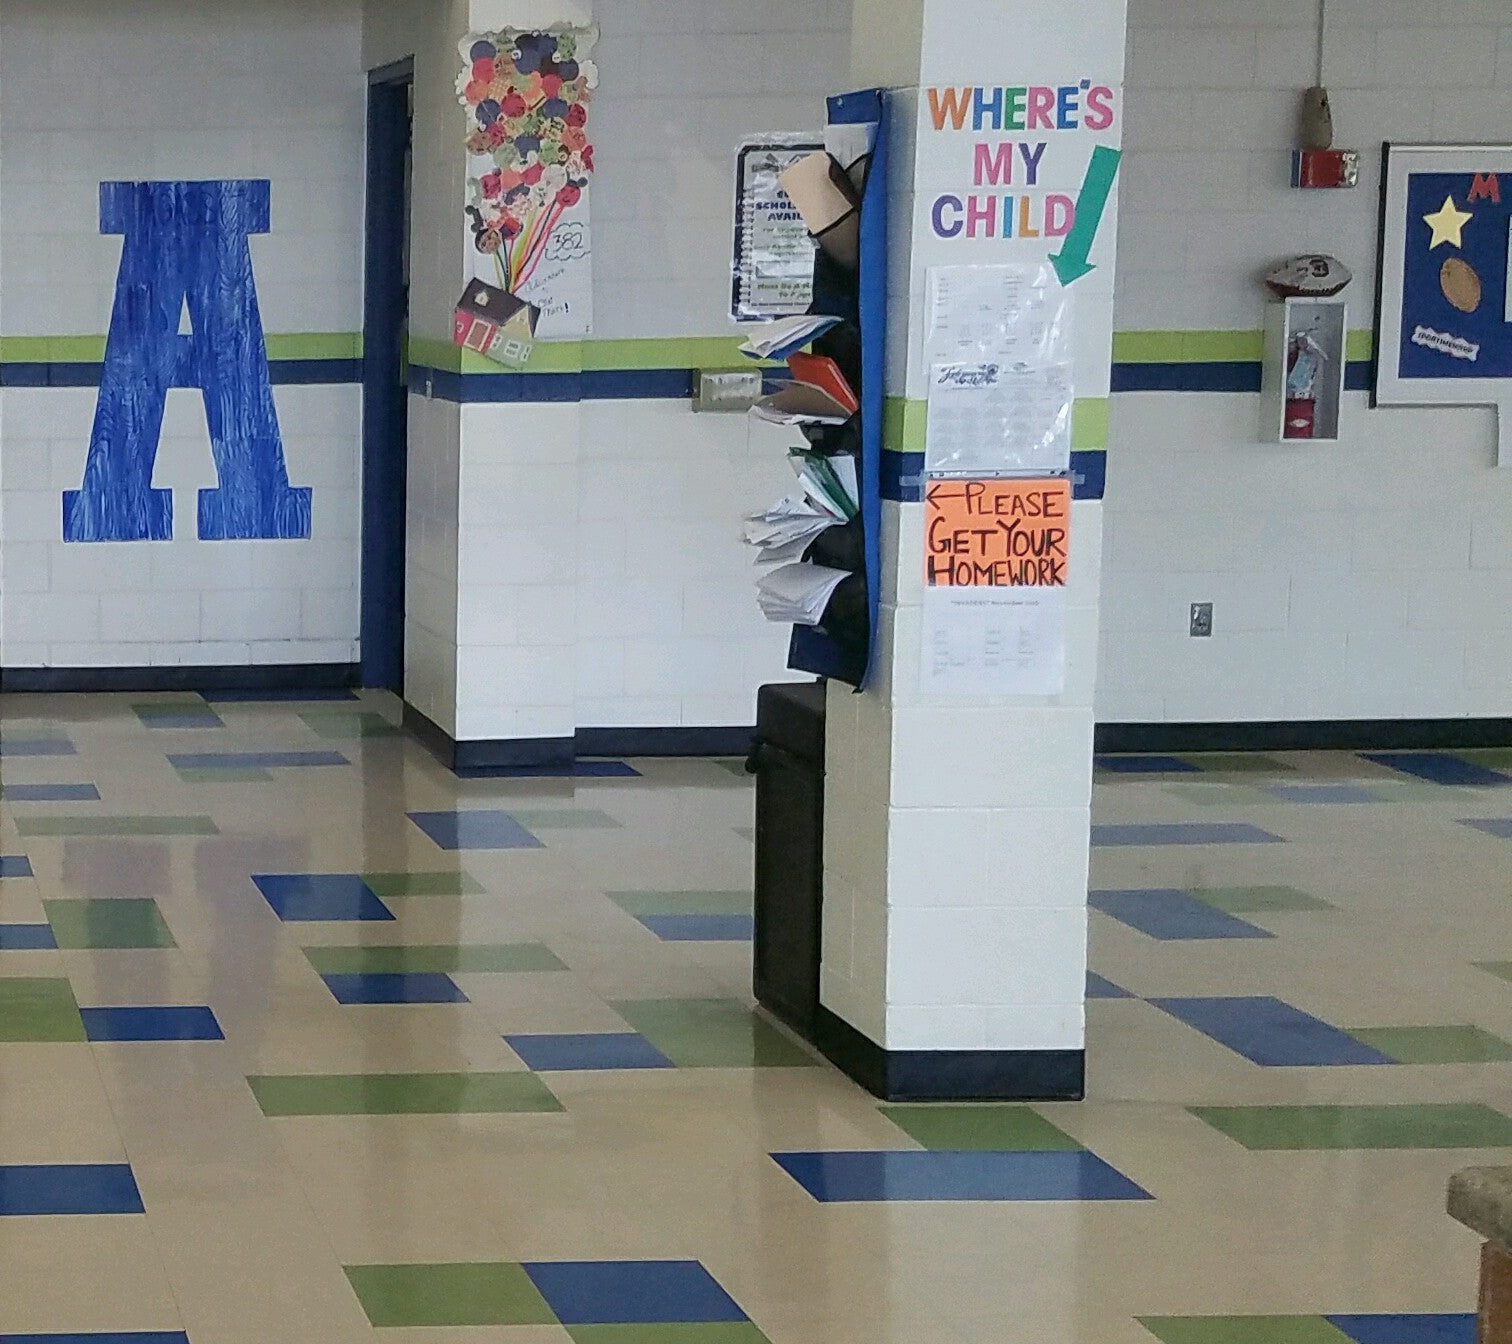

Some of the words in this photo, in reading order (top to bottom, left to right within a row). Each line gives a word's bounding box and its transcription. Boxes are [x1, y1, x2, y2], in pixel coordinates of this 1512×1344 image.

[927, 79, 1114, 131] WHERE'S
[973, 142, 1047, 186] MY
[755, 201, 796, 210] SCHOL
[931, 195, 1076, 238] CHILD
[62, 179, 312, 543] A
[965, 481, 1064, 518] PLEASE
[928, 516, 998, 554] GET
[996, 518, 1066, 557] YOUR
[927, 555, 1066, 586] HOMEWORK
